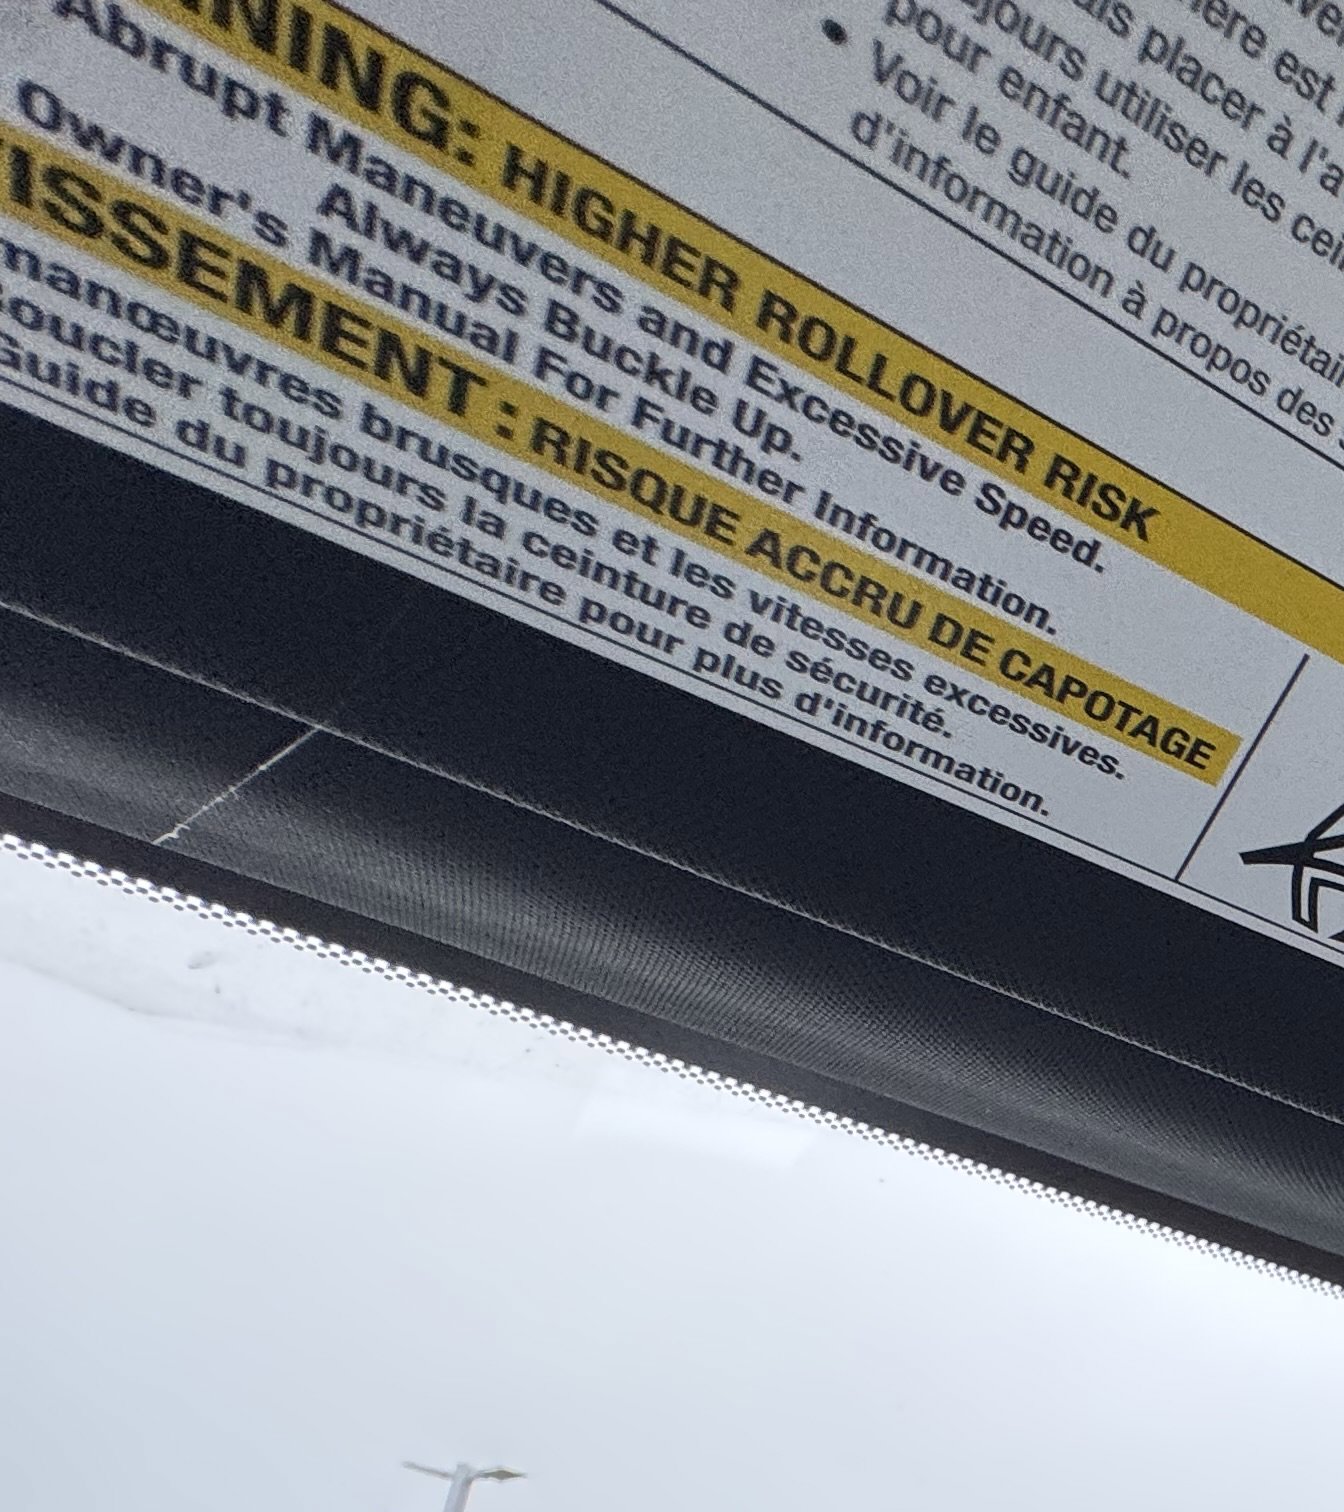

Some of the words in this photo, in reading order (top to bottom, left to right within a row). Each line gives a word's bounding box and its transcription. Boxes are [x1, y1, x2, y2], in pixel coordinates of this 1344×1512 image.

[874, 40, 955, 121] Voir
[962, 106, 1001, 155] le
[1008, 148, 1118, 233] guide
[1127, 226, 1175, 272] du
[885, 0, 991, 72] pour
[998, 66, 1129, 179] enfant.
[1095, 70, 1228, 176] utiliser
[1231, 161, 1285, 222] les
[1138, 26, 1264, 129] placer
[1267, 115, 1293, 159] à
[1274, 50, 1335, 112] est
[17, 80, 287, 247] Owner's
[307, 228, 519, 364] Manual
[534, 346, 620, 411] For
[631, 396, 805, 504] Further
[814, 490, 1056, 635] Information.
[53, 0, 289, 137] Abrupt
[306, 112, 623, 314] Maneuvers
[637, 306, 734, 374] and
[744, 355, 966, 496] Excessive
[975, 482, 1103, 573] Speed.
[181, 0, 480, 167] NING:
[502, 142, 741, 314] HIGHER
[756, 290, 1035, 474] ROLLOVER
[1043, 454, 1160, 542] RISK
[316, 184, 527, 317] Always
[544, 299, 718, 416] Buckle
[732, 399, 801, 461] Up.
[851, 112, 1114, 297] d'information
[1122, 281, 1147, 319] à
[1151, 308, 1270, 396] propos
[1277, 388, 1334, 436] des
[0, 138, 488, 417] ISSEMENT
[530, 417, 741, 546] RISQUE
[745, 528, 923, 629] ACCRU
[928, 613, 995, 666] DE
[999, 648, 1216, 770] CAPOTAGE
[0, 284, 203, 399] oucler
[219, 387, 446, 512] toujours
[462, 496, 506, 540] la
[522, 531, 711, 629] ceinture
[724, 622, 775, 658] de
[786, 651, 951, 738] sécurité.
[175, 420, 246, 468] du
[266, 458, 566, 605] propriétaire
[579, 597, 684, 654] pour
[692, 647, 783, 699] plus
[795, 693, 1048, 816] d'information.
[360, 402, 599, 537] brusques
[612, 529, 659, 566] et
[670, 548, 735, 599] les
[750, 590, 914, 681] vitesses
[924, 675, 1124, 779] excessives.
